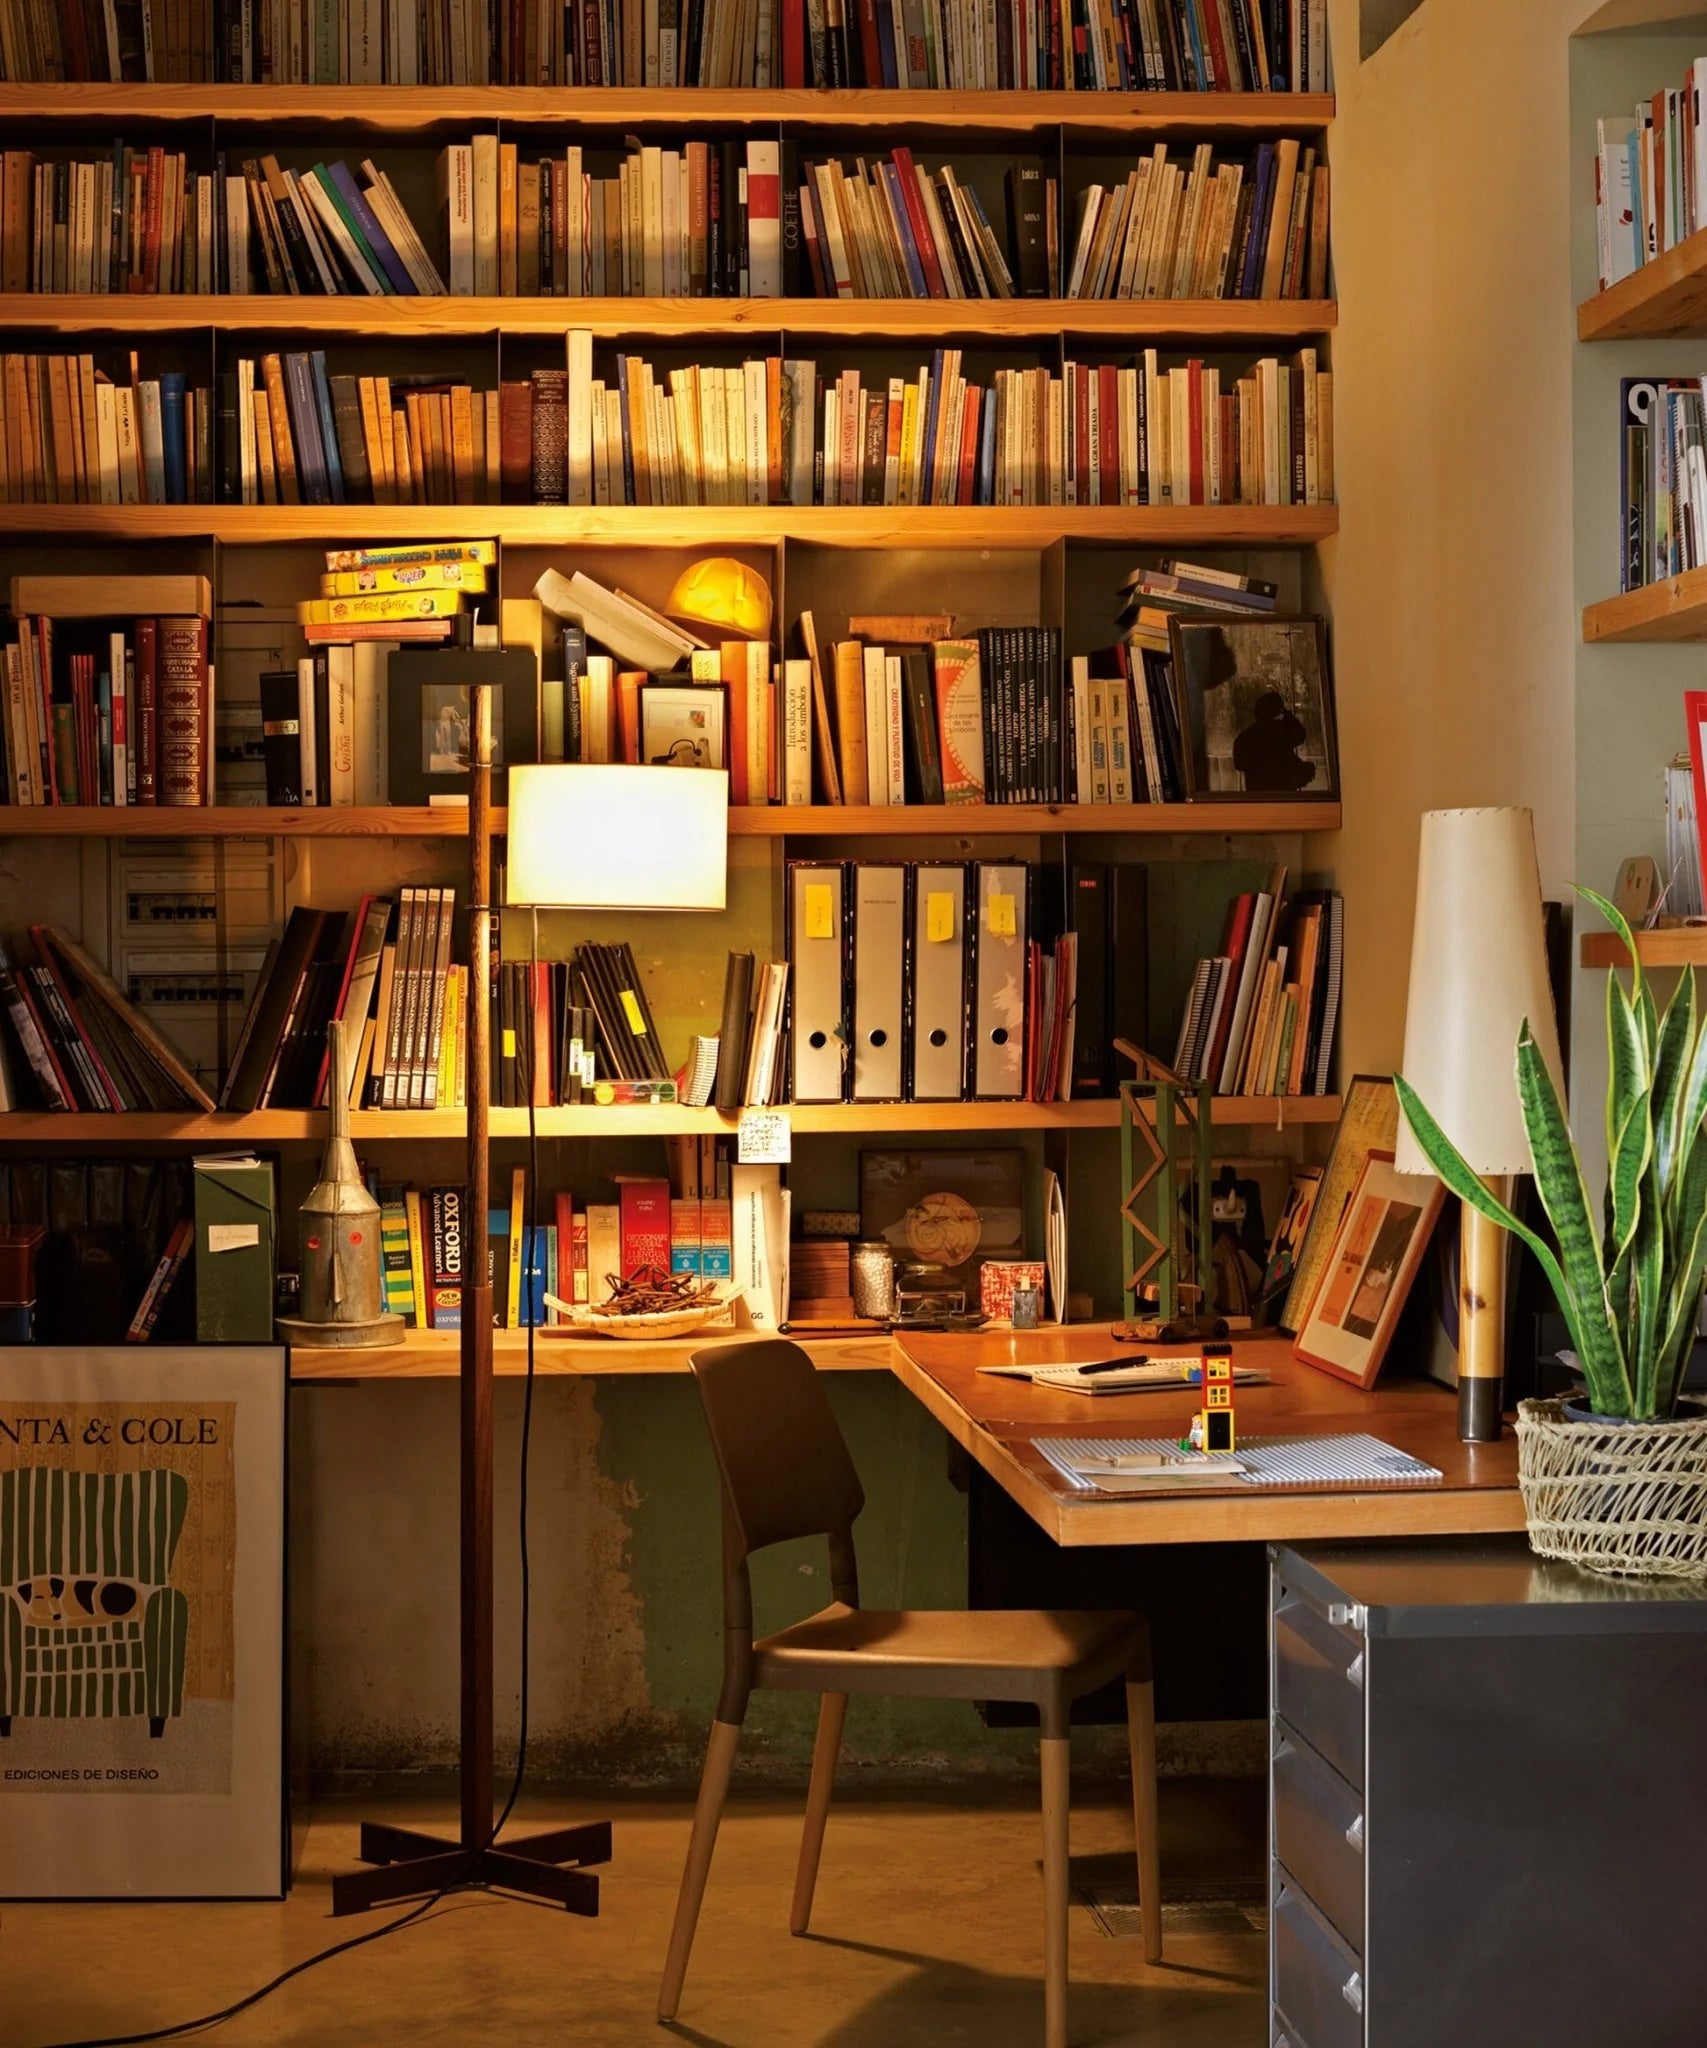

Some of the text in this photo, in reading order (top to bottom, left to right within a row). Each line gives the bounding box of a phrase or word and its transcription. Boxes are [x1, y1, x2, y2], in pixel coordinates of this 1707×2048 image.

[665, 33, 673, 72] CUENTOS
[784, 190, 798, 249] GOETHE
[558, 238, 563, 247] UN
[844, 414, 854, 464] MASNAVI
[1092, 463, 1098, 472] LA
[845, 471, 853, 484] EL
[11, 651, 19, 683] Poblenou
[167, 665, 193, 673] CATALÀ
[13, 692, 21, 704] Fet
[570, 661, 582, 738] Signs and Symbols
[798, 686, 807, 726] símbolos
[891, 688, 899, 725] CREATIVIDAD
[786, 689, 797, 747] Introducción
[799, 730, 807, 742] los
[892, 730, 900, 759] PLENITUD
[334, 735, 351, 773] Geisha
[1030, 748, 1036, 758] LA
[893, 760, 900, 768] DE
[1021, 756, 1027, 766] LA
[893, 770, 901, 783] VIDA
[433, 1192, 444, 1274] Advanced Learner's
[444, 1192, 461, 1274] OXFORD
[626, 1233, 668, 1241] DICCIONARI
[625, 1257, 669, 1265] CATALANA
[751, 1312, 764, 1320] GG
[83, 1418, 112, 1446] &
[121, 1418, 219, 1445] COLE
[4, 1766, 160, 1781] EDICIONES DE DISEÑO
